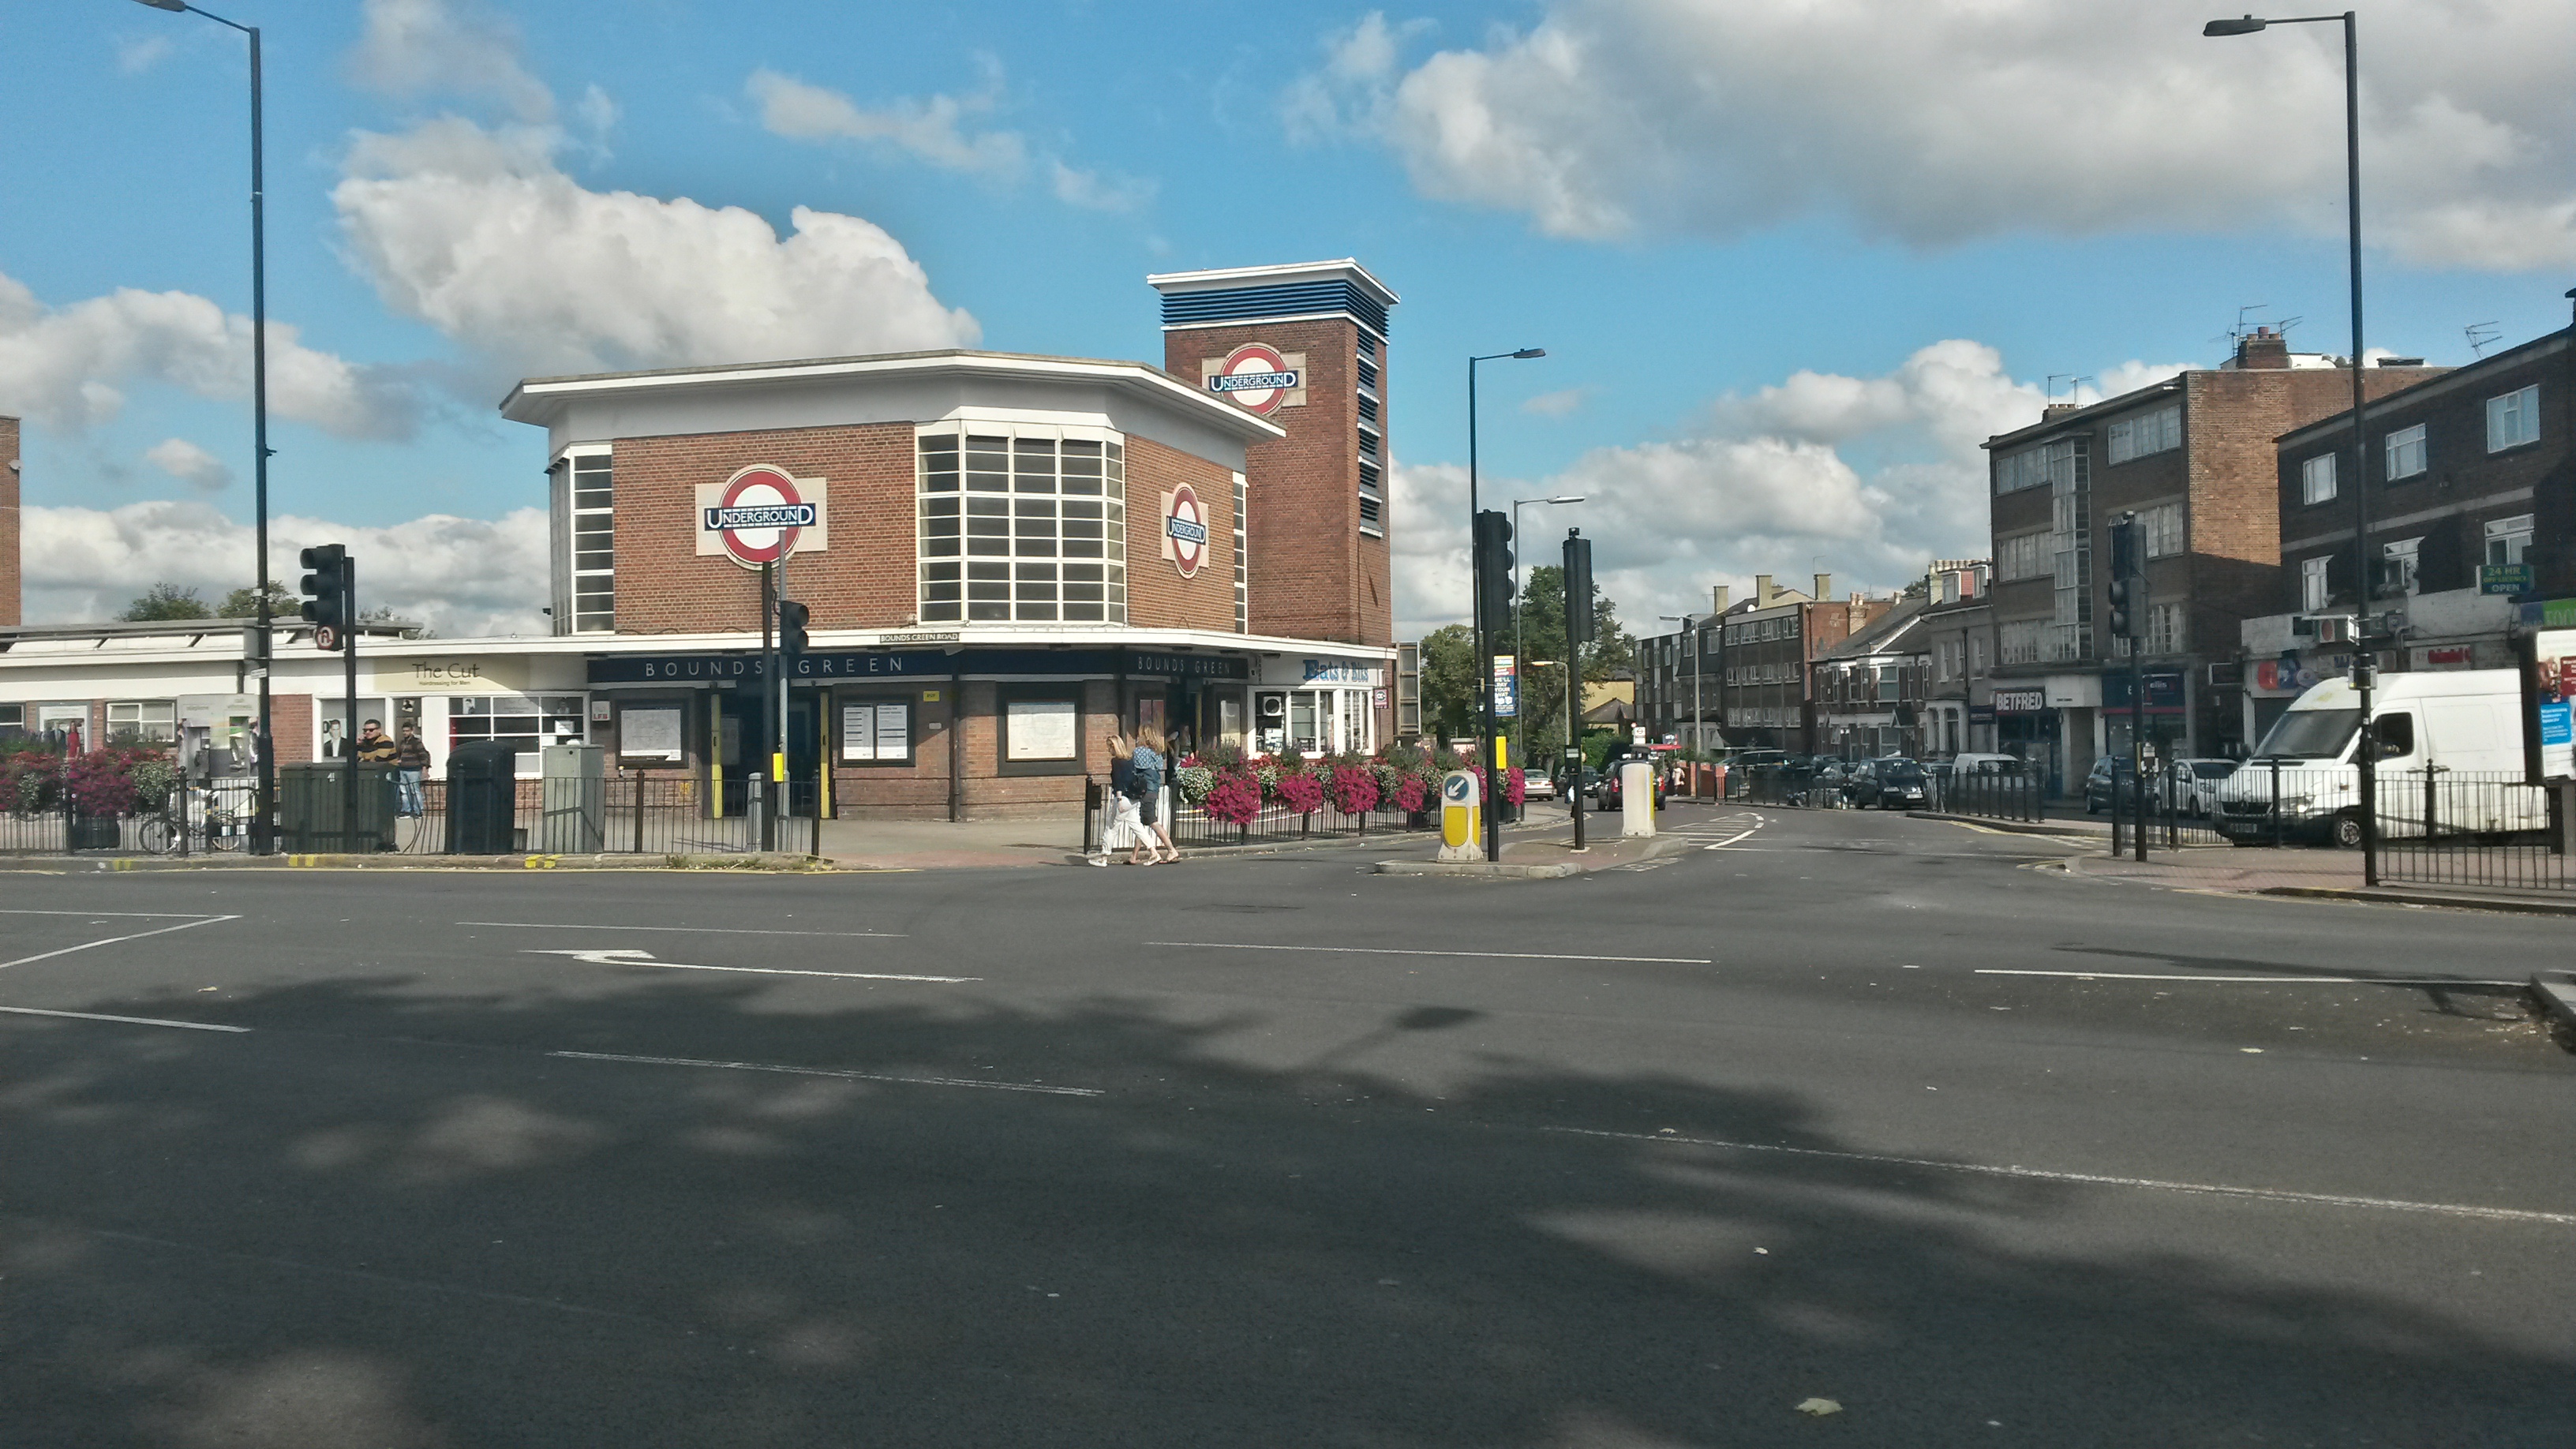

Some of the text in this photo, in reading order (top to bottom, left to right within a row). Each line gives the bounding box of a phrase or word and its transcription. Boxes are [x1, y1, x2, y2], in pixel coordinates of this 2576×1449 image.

[1211, 373, 1296, 391] UNDERGROUND
[707, 505, 813, 528] UNDERGROUND
[1167, 517, 1205, 543] UNDERGROUND
[2488, 567, 2502, 576] 24
[2492, 583, 2520, 592] OPEN
[412, 661, 480, 678] The Cut
[646, 657, 902, 676] BOUNDS GREEN
[1138, 656, 1230, 674] BOUNDS GREEN
[1303, 659, 1369, 683] Eats & Bits
[1996, 691, 2043, 710] BETFRED
